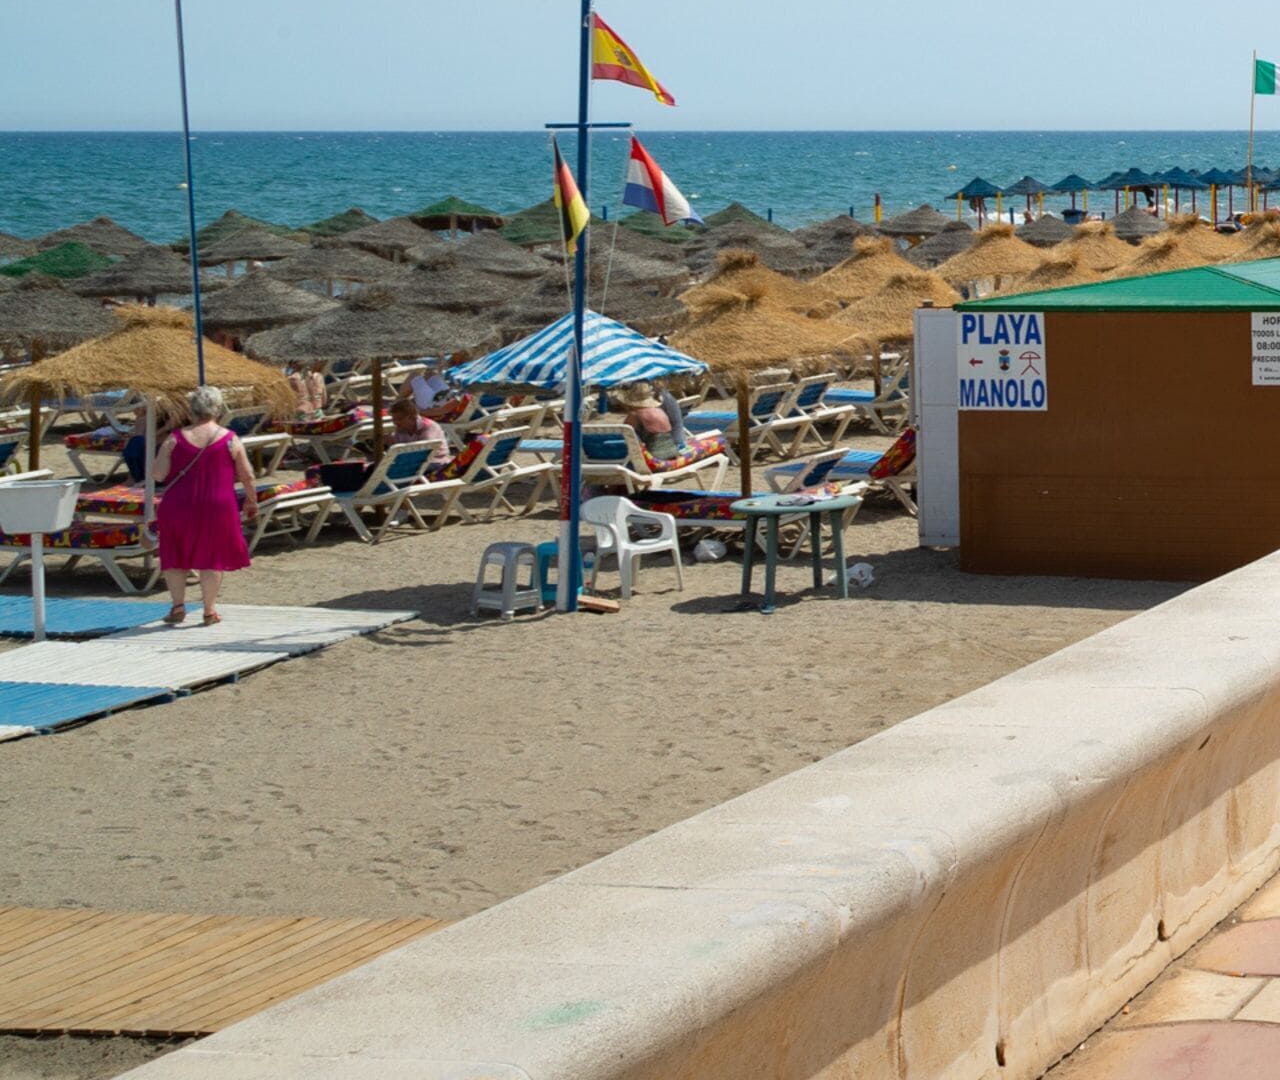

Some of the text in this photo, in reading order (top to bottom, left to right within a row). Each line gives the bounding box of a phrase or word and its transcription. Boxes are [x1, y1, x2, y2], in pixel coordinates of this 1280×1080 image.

[962, 314, 1042, 344] PLAYA
[1252, 330, 1275, 338] TODOS
[1256, 342, 1280, 350] 08:00
[960, 379, 1045, 407] MANOLO
